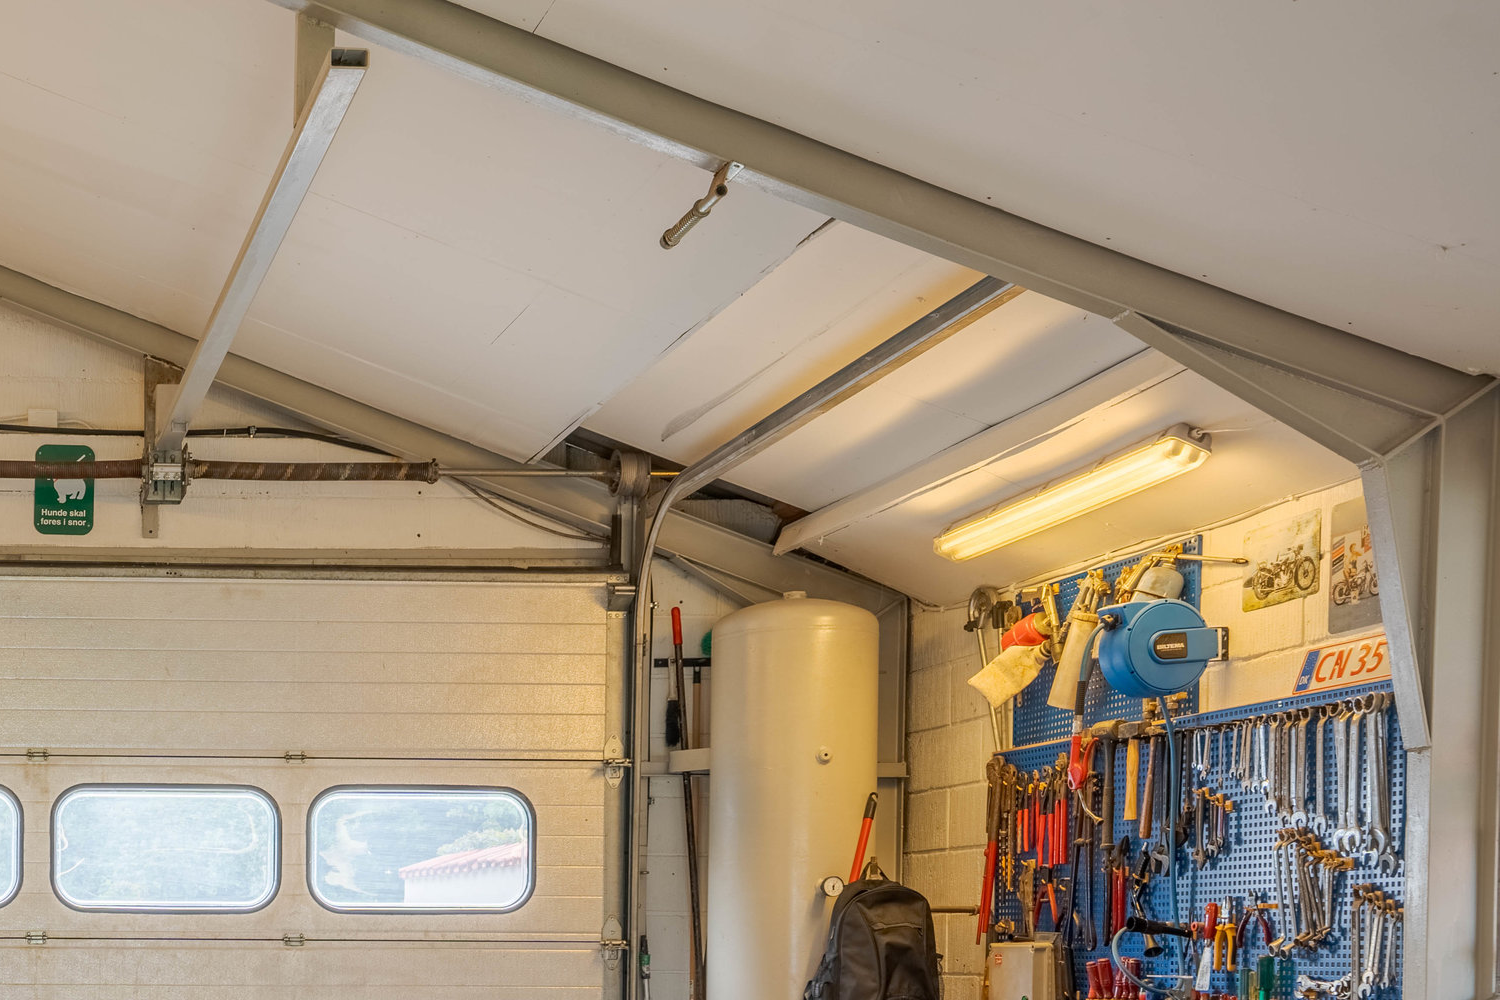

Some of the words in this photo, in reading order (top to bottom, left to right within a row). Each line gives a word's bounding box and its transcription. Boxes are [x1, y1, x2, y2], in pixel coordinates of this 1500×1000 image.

[41, 508, 68, 517] Hunde
[69, 509, 86, 517] skal
[40, 517, 62, 526] føres
[1315, 647, 1353, 683] CN
